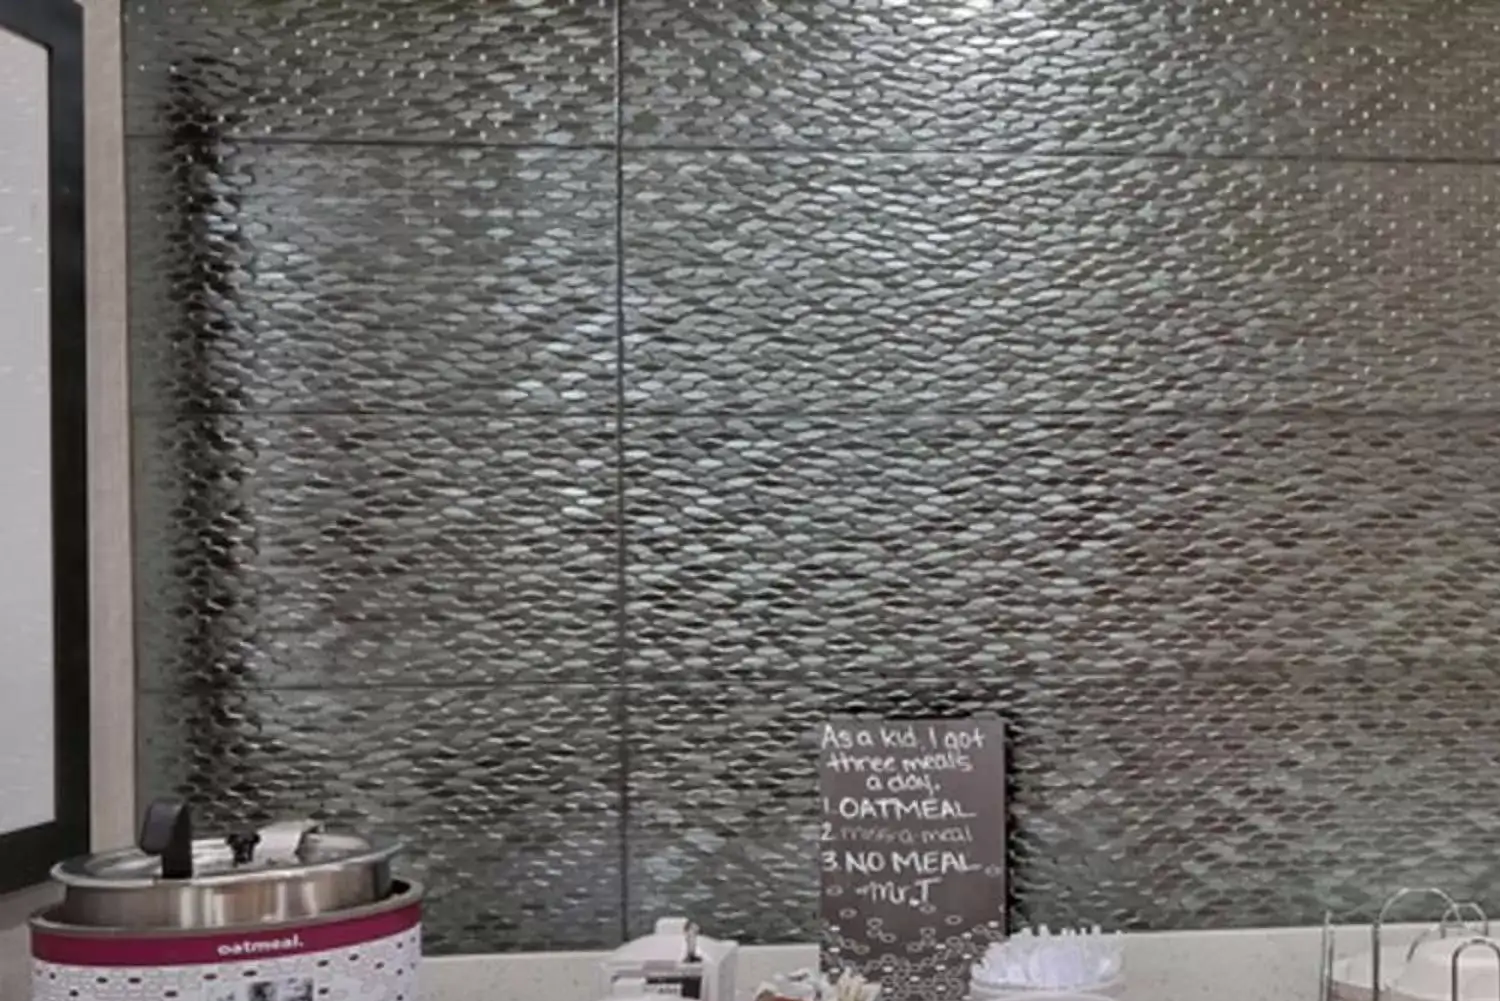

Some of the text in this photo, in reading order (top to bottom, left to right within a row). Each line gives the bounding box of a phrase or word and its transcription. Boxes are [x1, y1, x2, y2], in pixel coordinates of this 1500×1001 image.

[821, 724, 853, 749] As
[944, 728, 986, 757] got
[826, 751, 974, 773] three meals
[866, 774, 941, 797] a day.
[839, 797, 978, 821] OATMEAL
[921, 824, 973, 844] meal
[845, 850, 886, 875] NO
[891, 850, 983, 874] MEAL
[217, 934, 304, 957] oatmeal.
